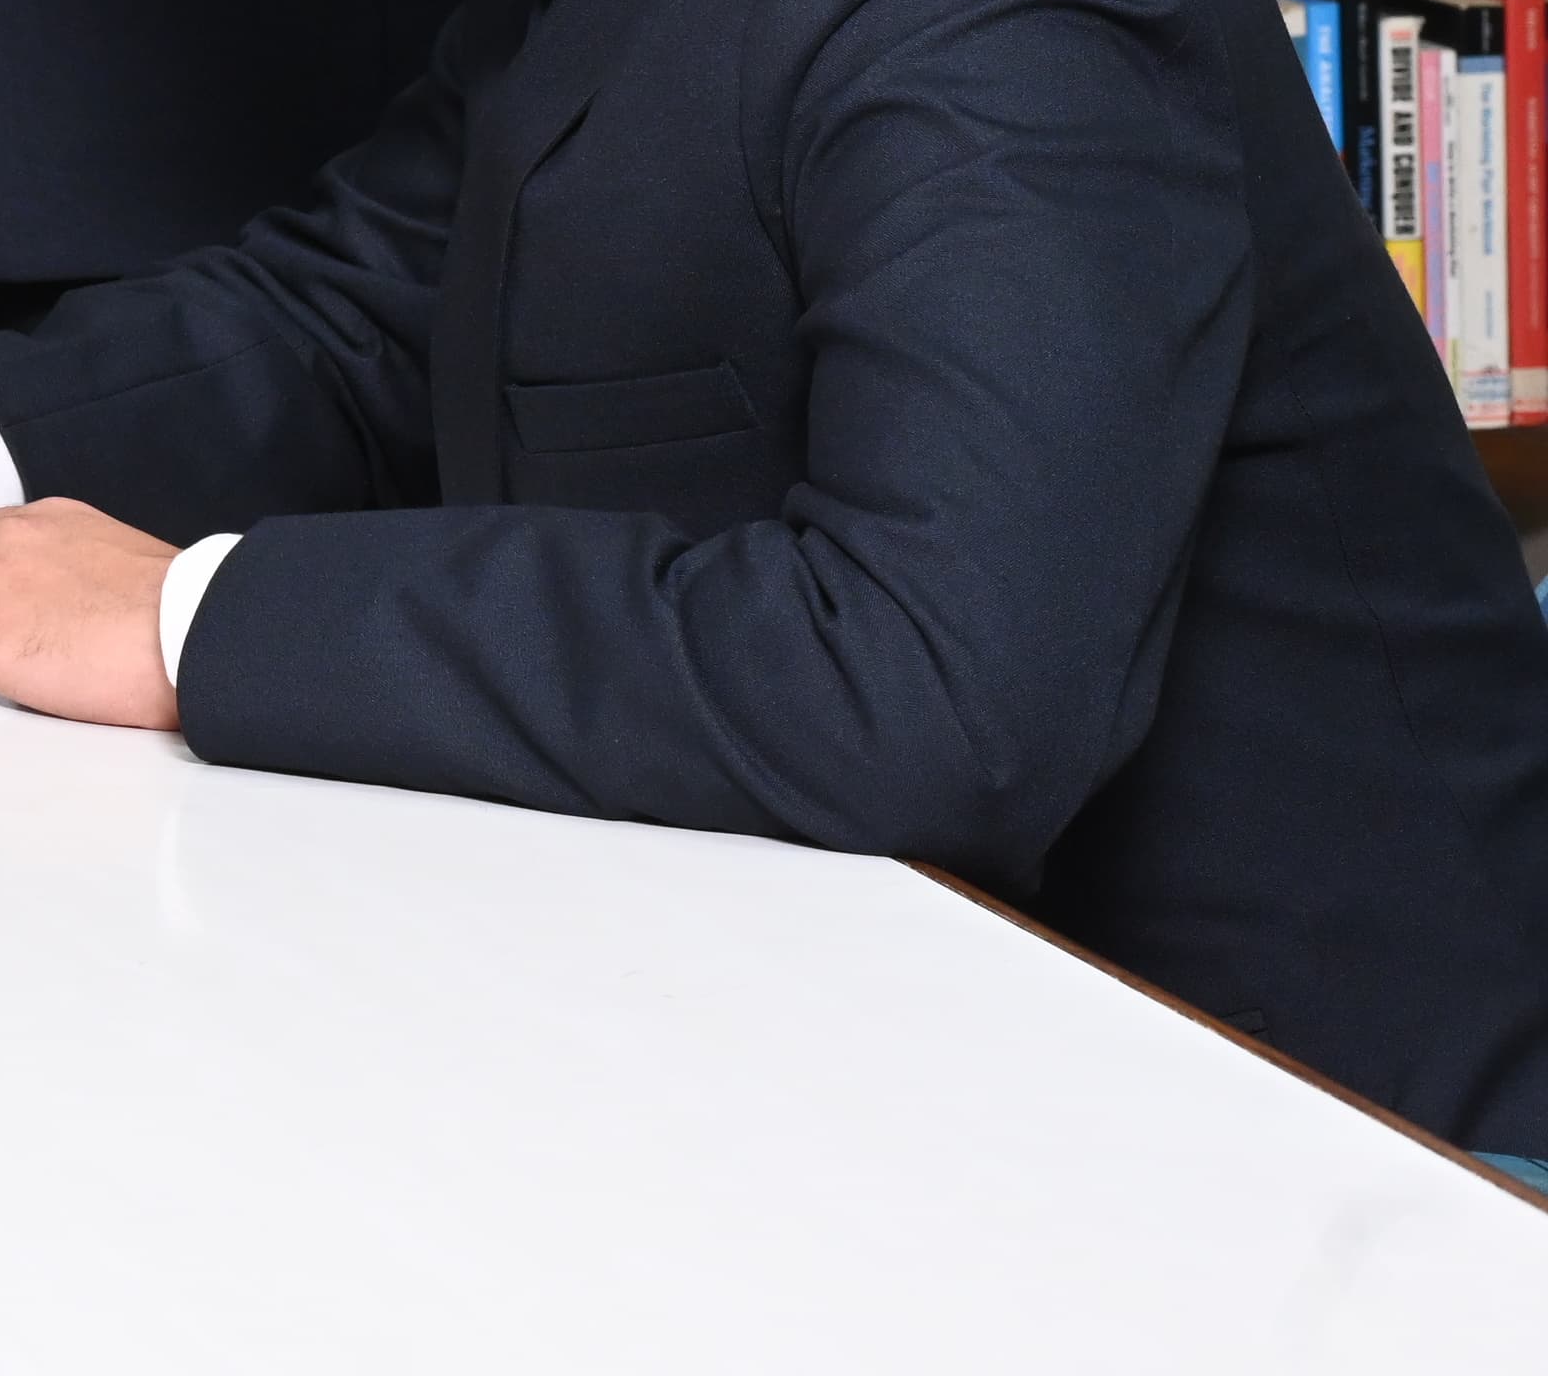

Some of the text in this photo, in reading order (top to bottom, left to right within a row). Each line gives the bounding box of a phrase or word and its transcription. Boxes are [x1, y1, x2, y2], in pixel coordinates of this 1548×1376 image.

[1393, 48, 1414, 234] DIVIDE AND CONQUER
